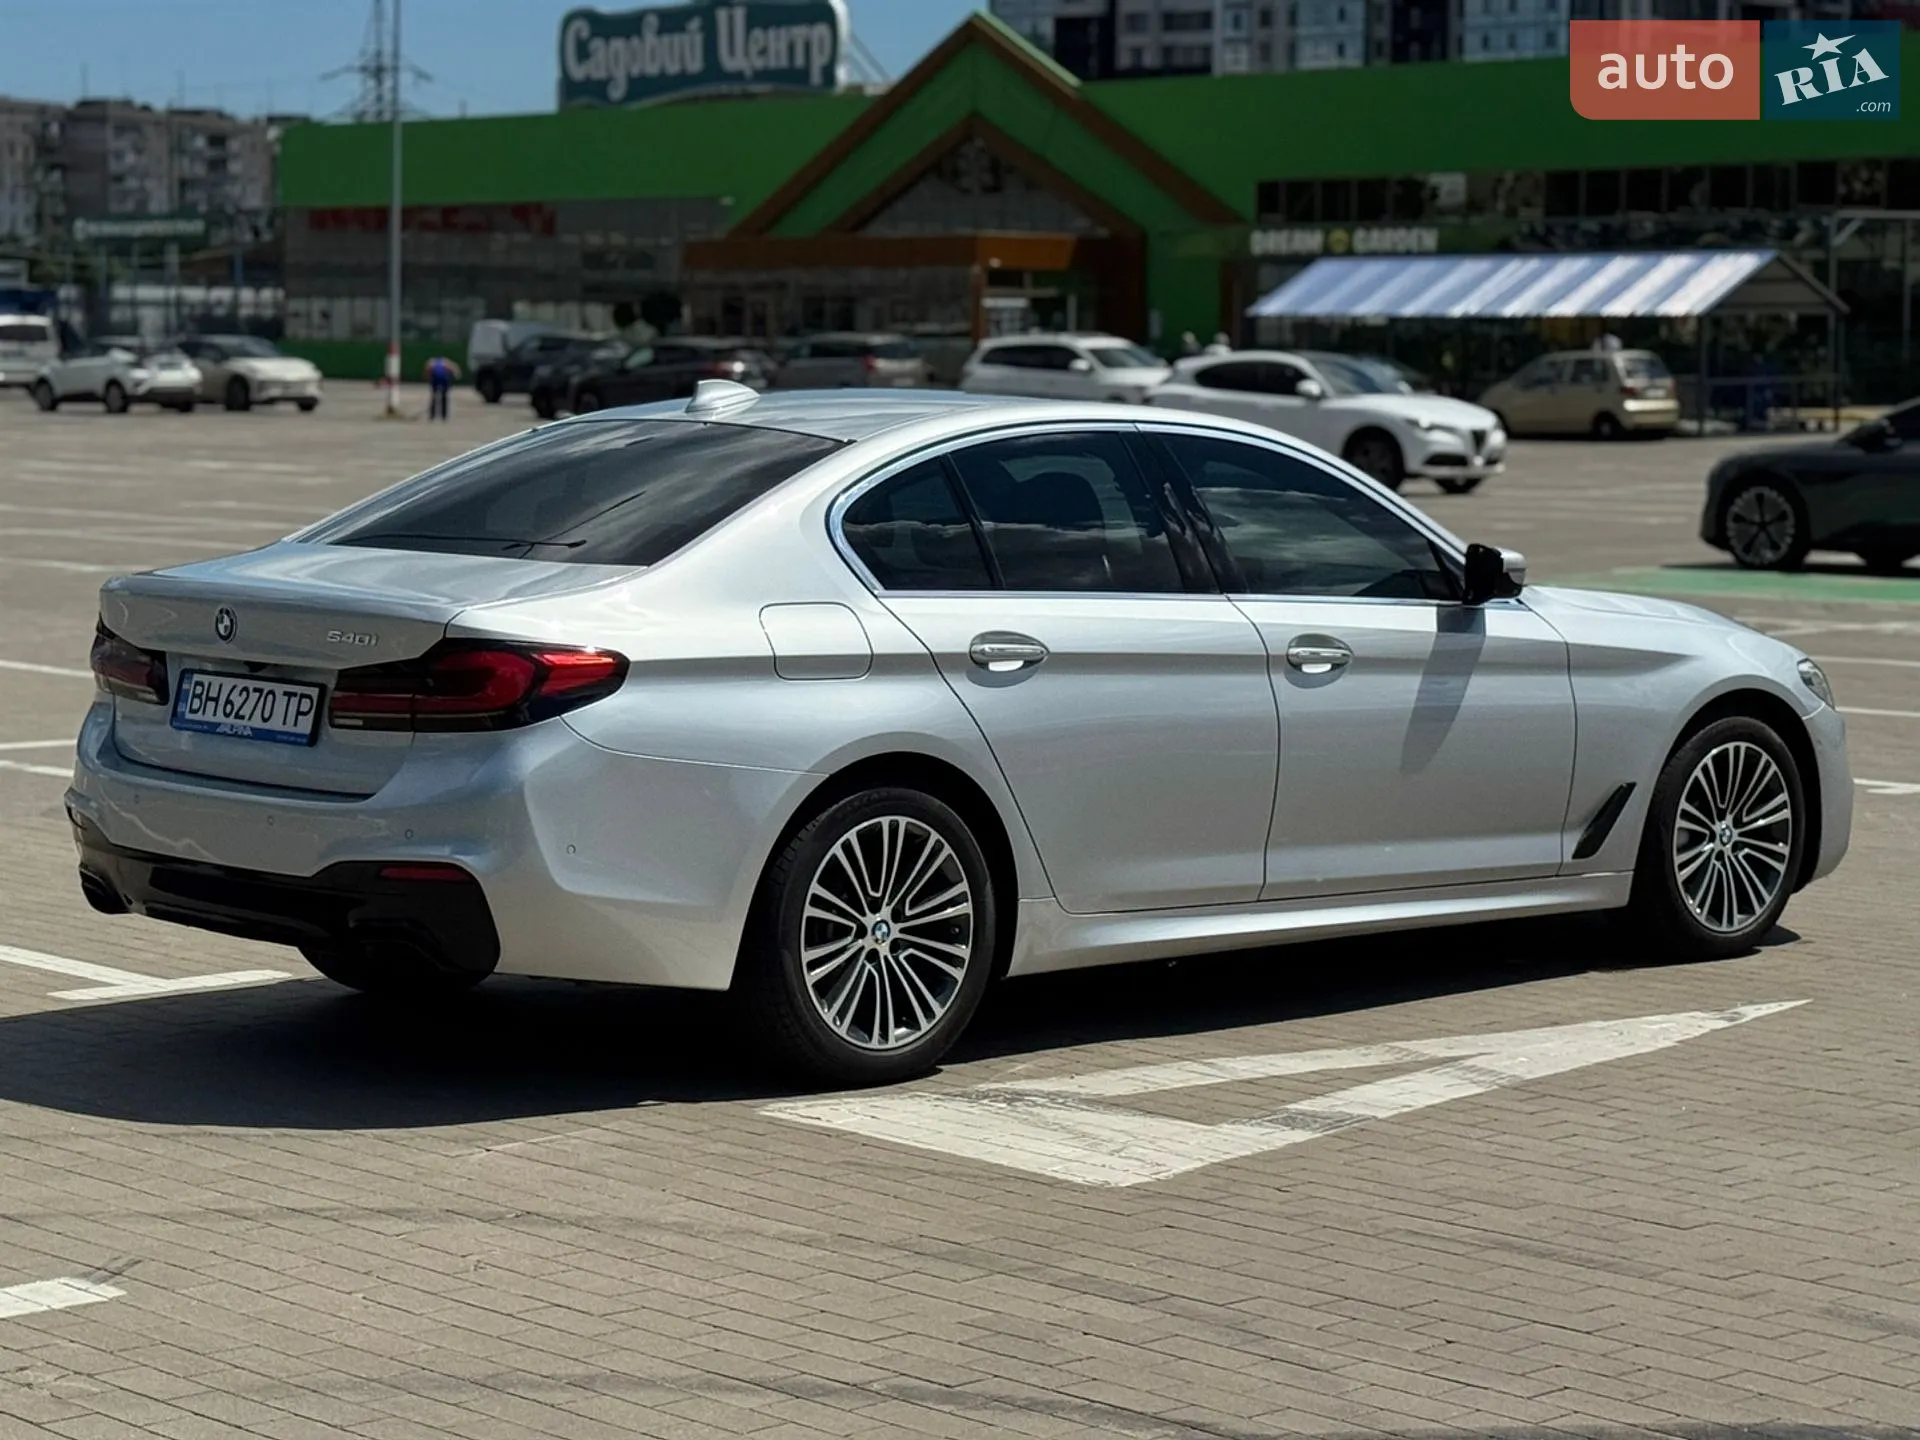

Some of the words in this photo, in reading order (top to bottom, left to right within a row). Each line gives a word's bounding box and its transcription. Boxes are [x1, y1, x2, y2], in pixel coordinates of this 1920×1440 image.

[563, 12, 705, 101] Садовий
[715, 6, 832, 87] Центр
[326, 629, 379, 647] 540i
[223, 684, 277, 723] 6270
